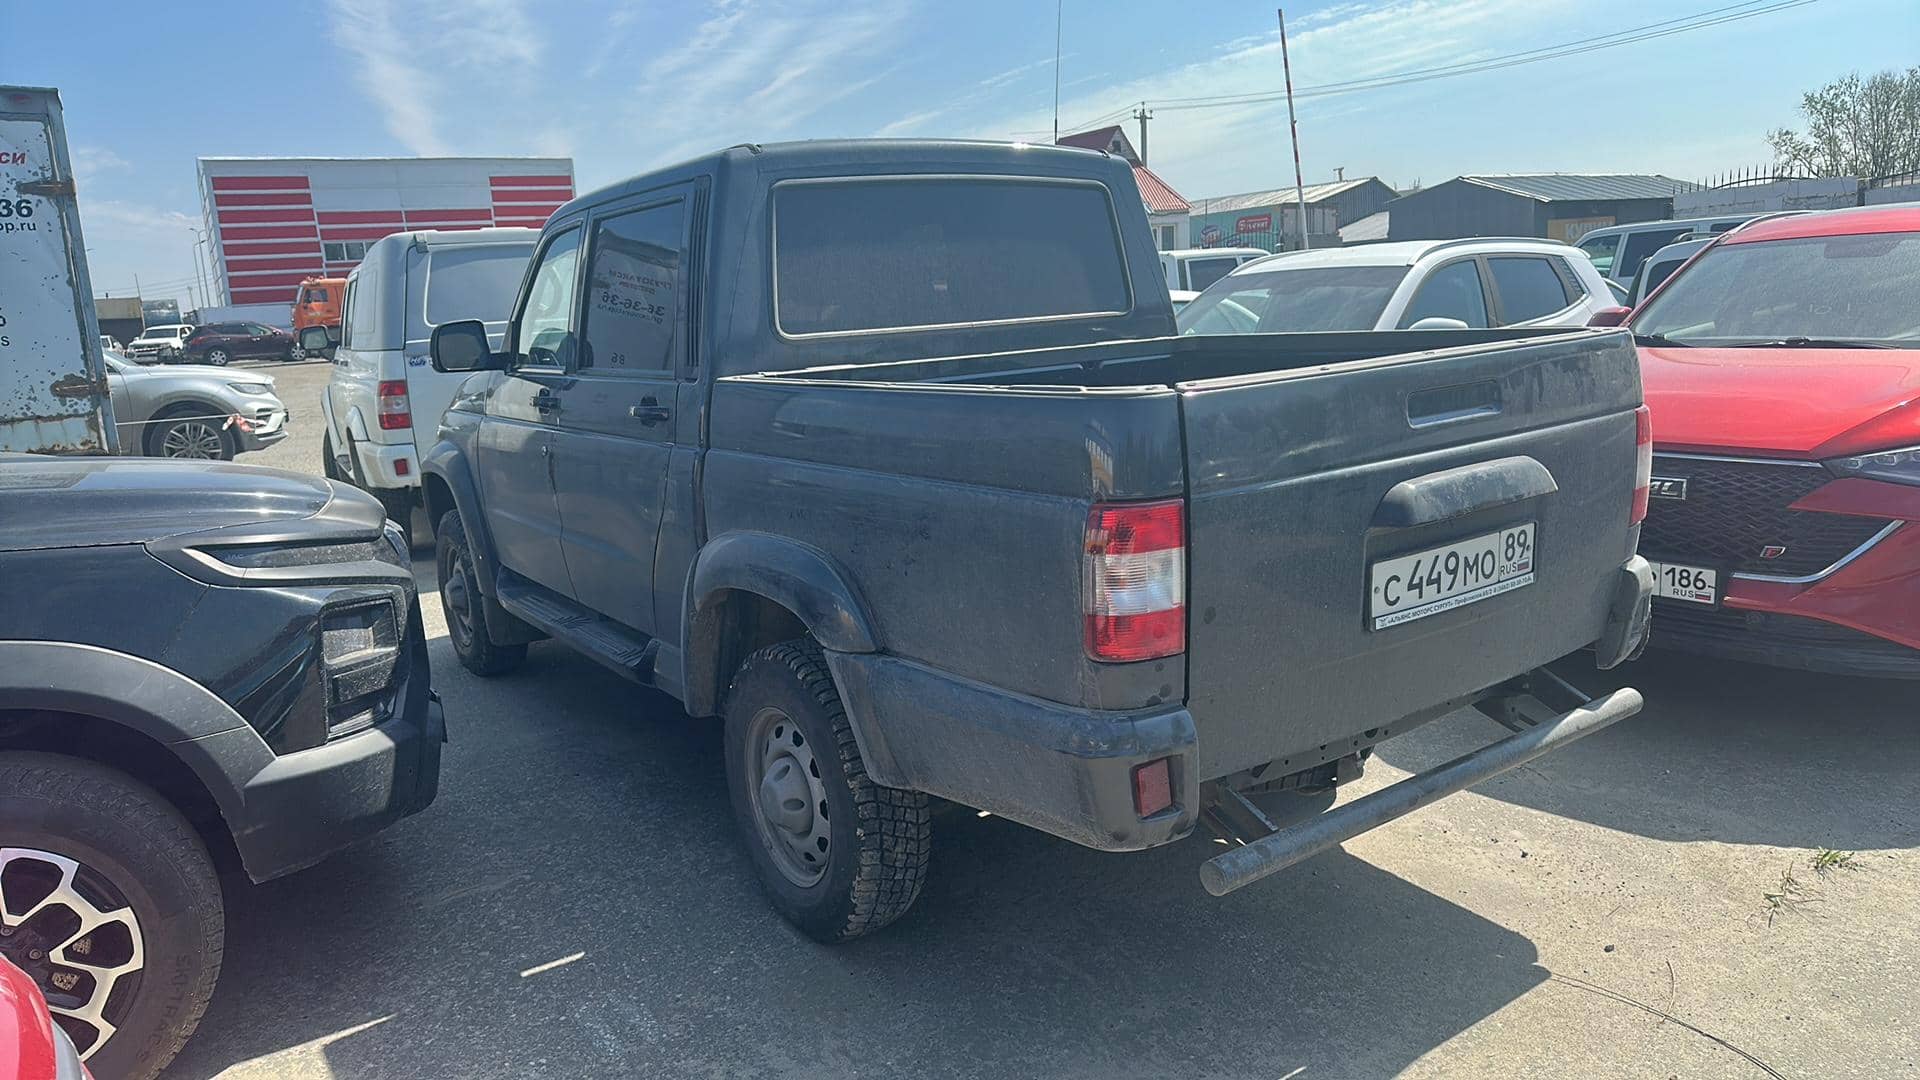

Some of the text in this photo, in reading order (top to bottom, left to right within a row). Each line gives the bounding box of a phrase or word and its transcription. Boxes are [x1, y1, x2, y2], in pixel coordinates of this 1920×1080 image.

[1504, 529, 1528, 562] 89
[1500, 561, 1517, 575] RUS
[1664, 567, 1707, 590] 186
[1672, 587, 1694, 599] RUS
